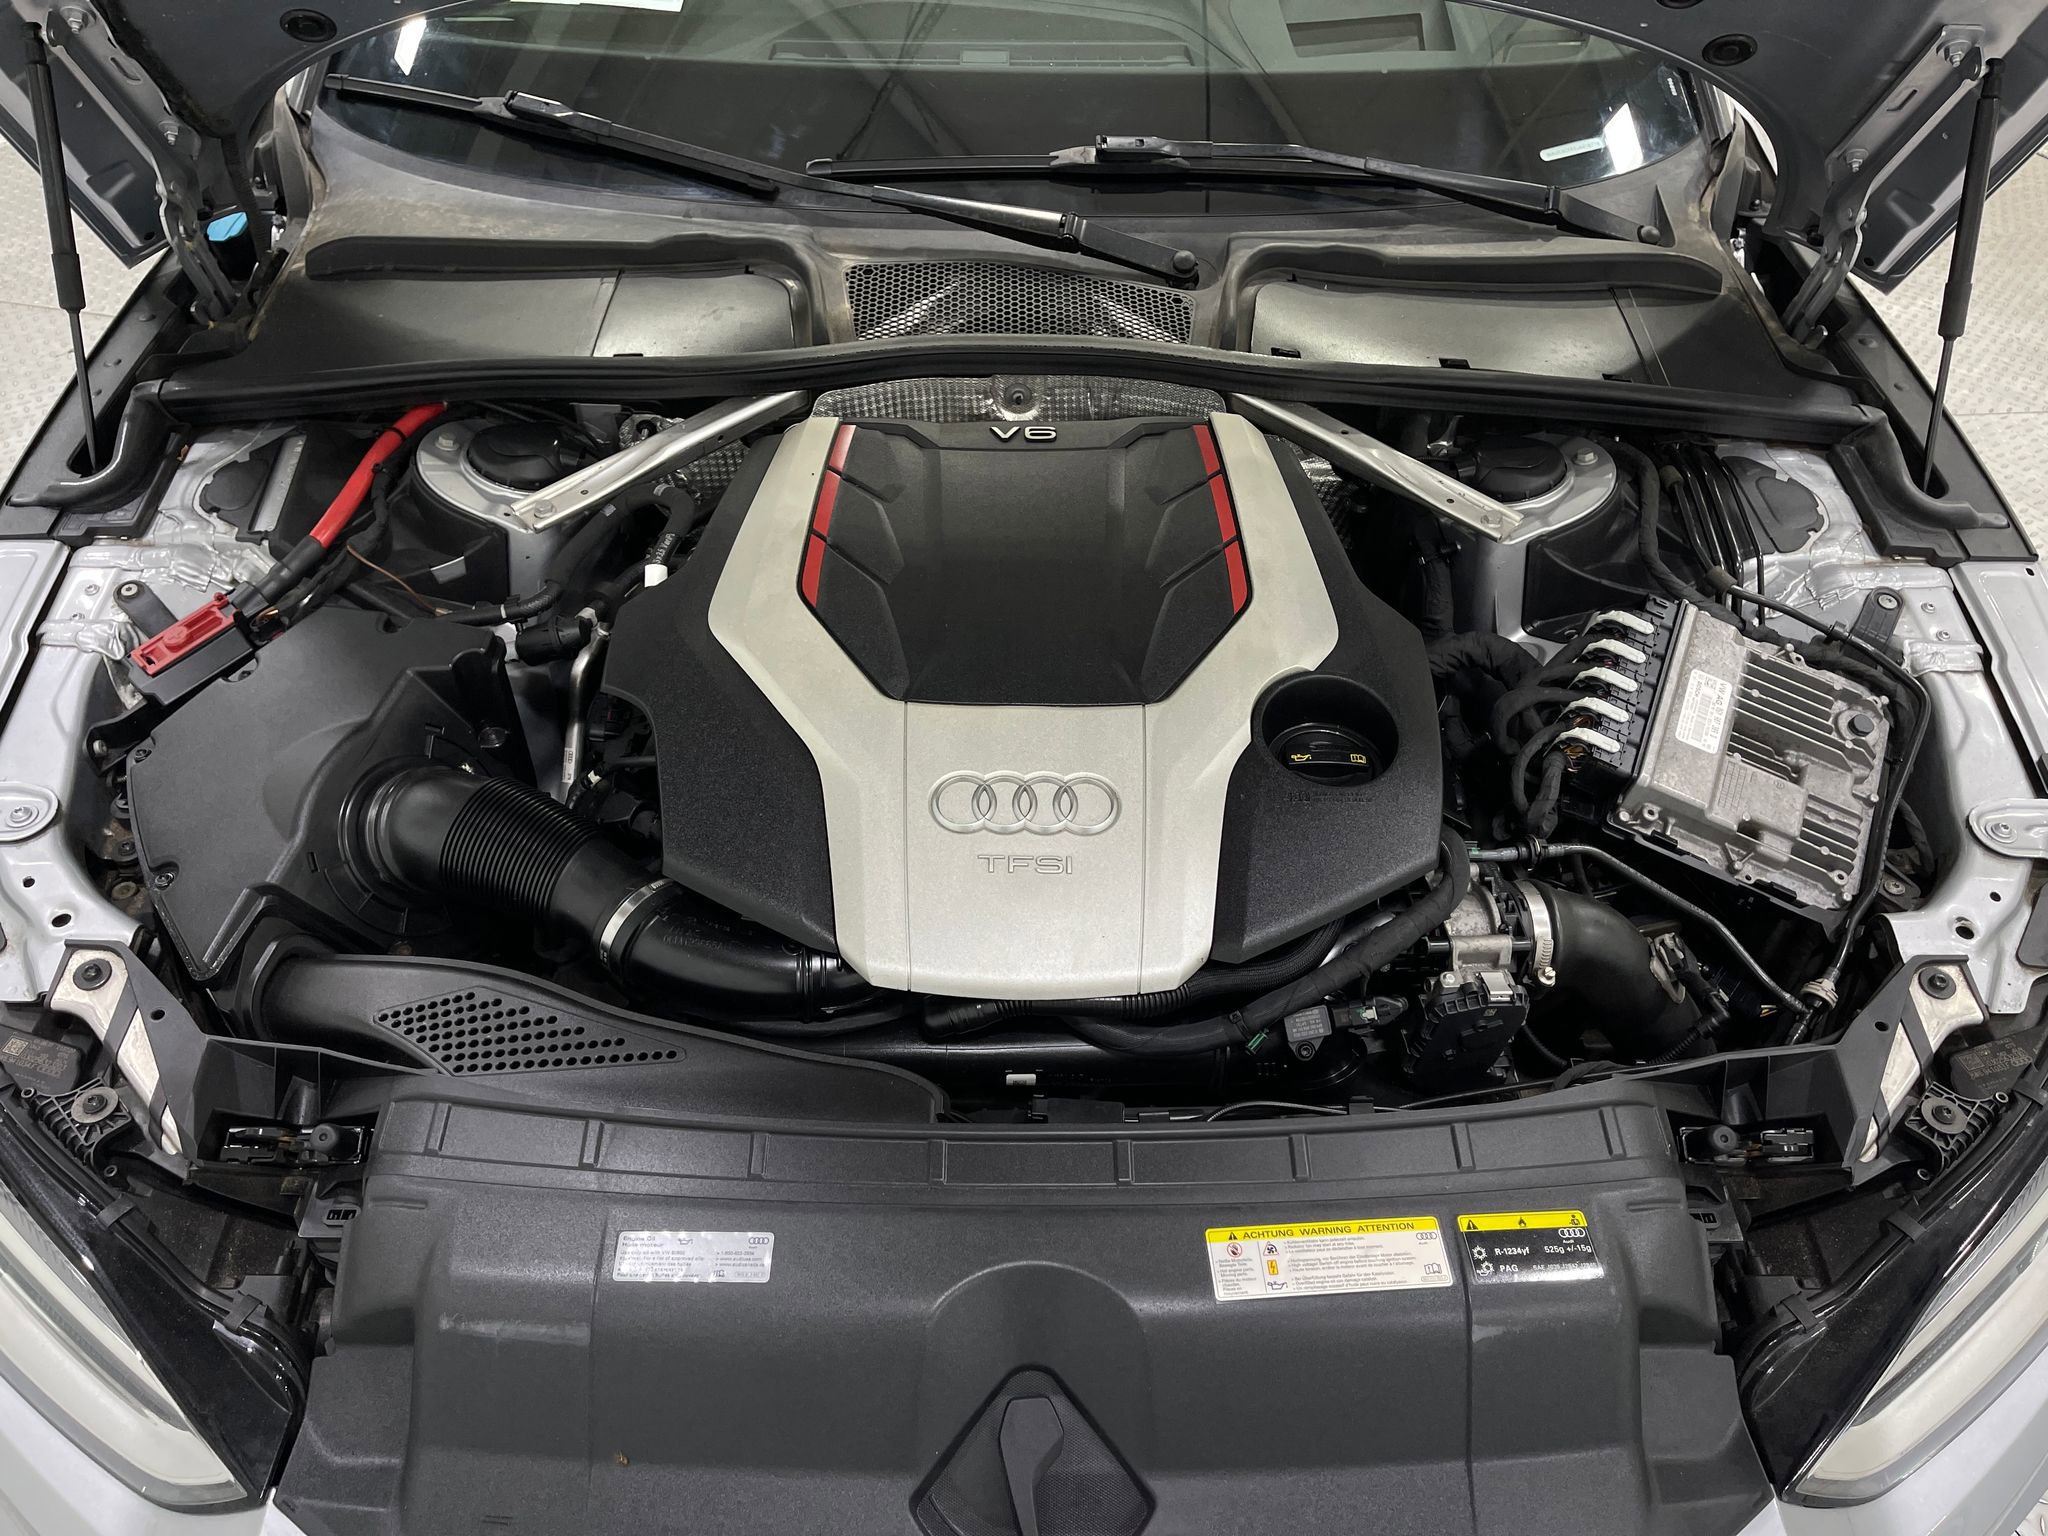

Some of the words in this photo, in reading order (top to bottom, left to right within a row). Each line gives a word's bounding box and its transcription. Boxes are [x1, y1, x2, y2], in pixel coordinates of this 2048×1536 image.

[990, 426, 1057, 442] V6
[977, 854, 1073, 875] TFSI
[1243, 1229, 1294, 1240] ACHTUNG
[1299, 1225, 1352, 1236] WARNING
[1357, 1222, 1415, 1233] ATTENTION
[1494, 1246, 1530, 1256] R-1234yf
[1544, 1245, 1565, 1255] 525g
[1566, 1244, 1592, 1254] +/-15g
[1499, 1264, 1519, 1273] PAG
